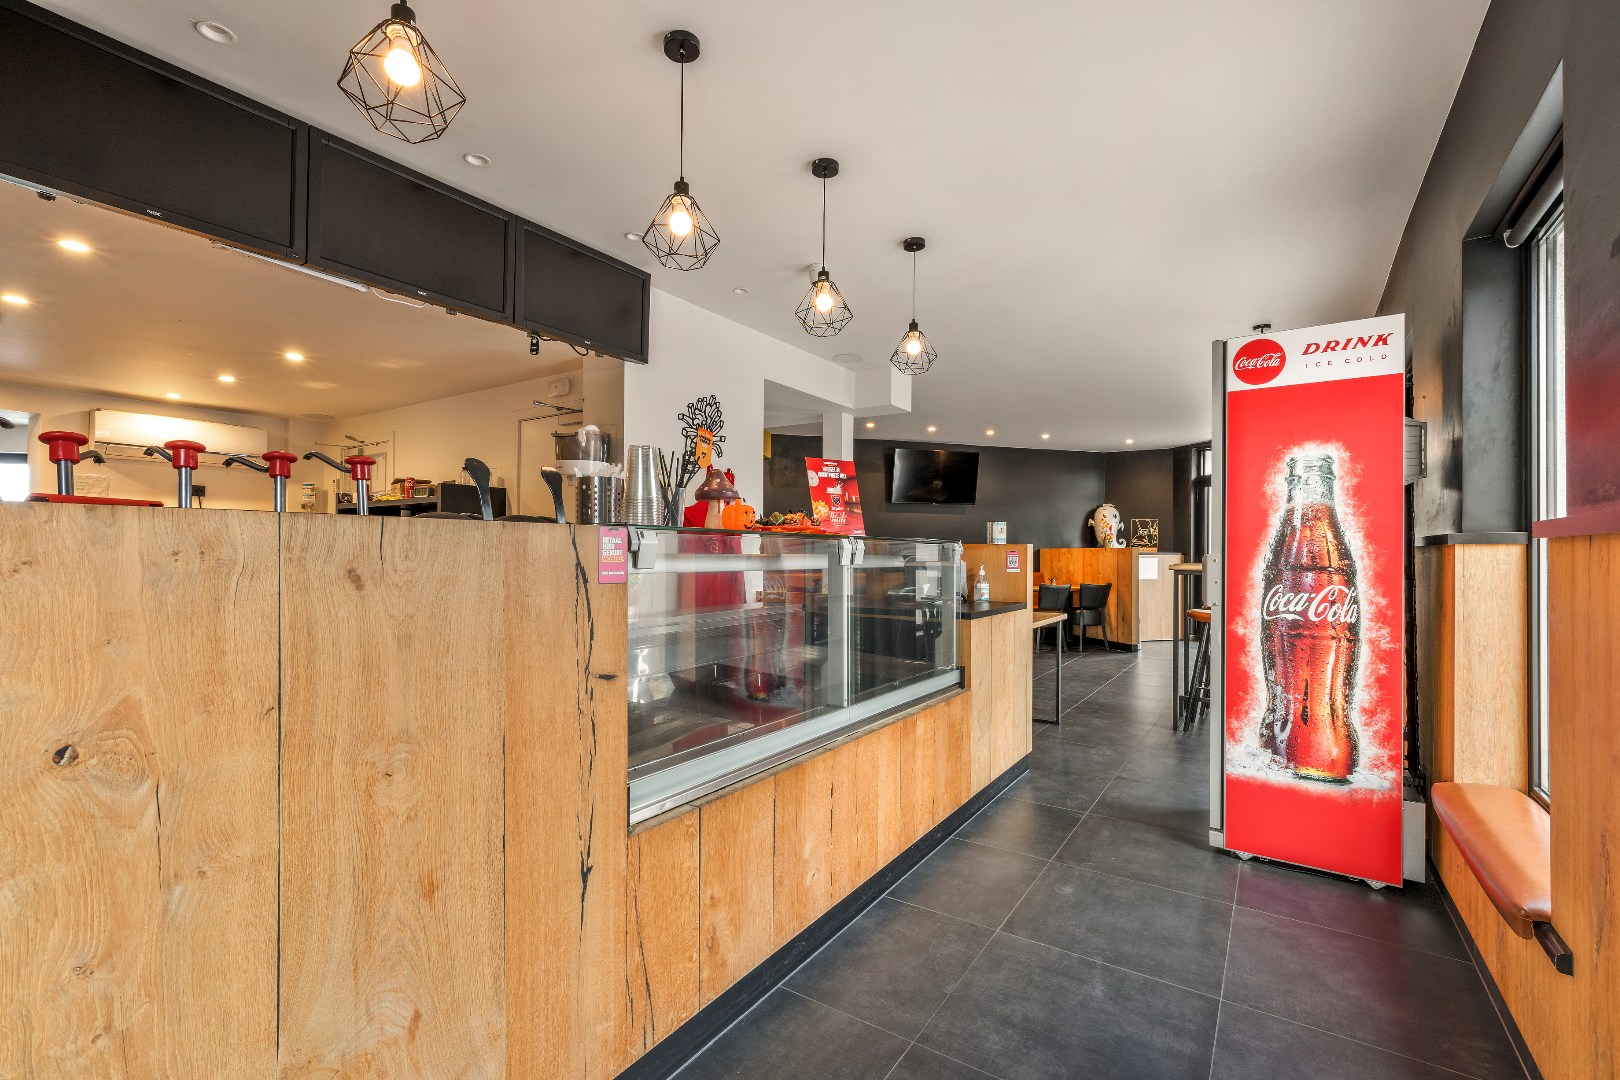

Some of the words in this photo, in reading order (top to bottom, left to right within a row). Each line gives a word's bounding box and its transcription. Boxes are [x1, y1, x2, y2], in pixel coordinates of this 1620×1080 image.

[1301, 332, 1394, 356] DRINK
[1235, 352, 1284, 371] Coca-Cola
[1305, 360, 1333, 369] ICE
[1344, 353, 1388, 364] COLD
[602, 536, 623, 544] BETAAL
[1262, 584, 1358, 624] Coca-Cola
